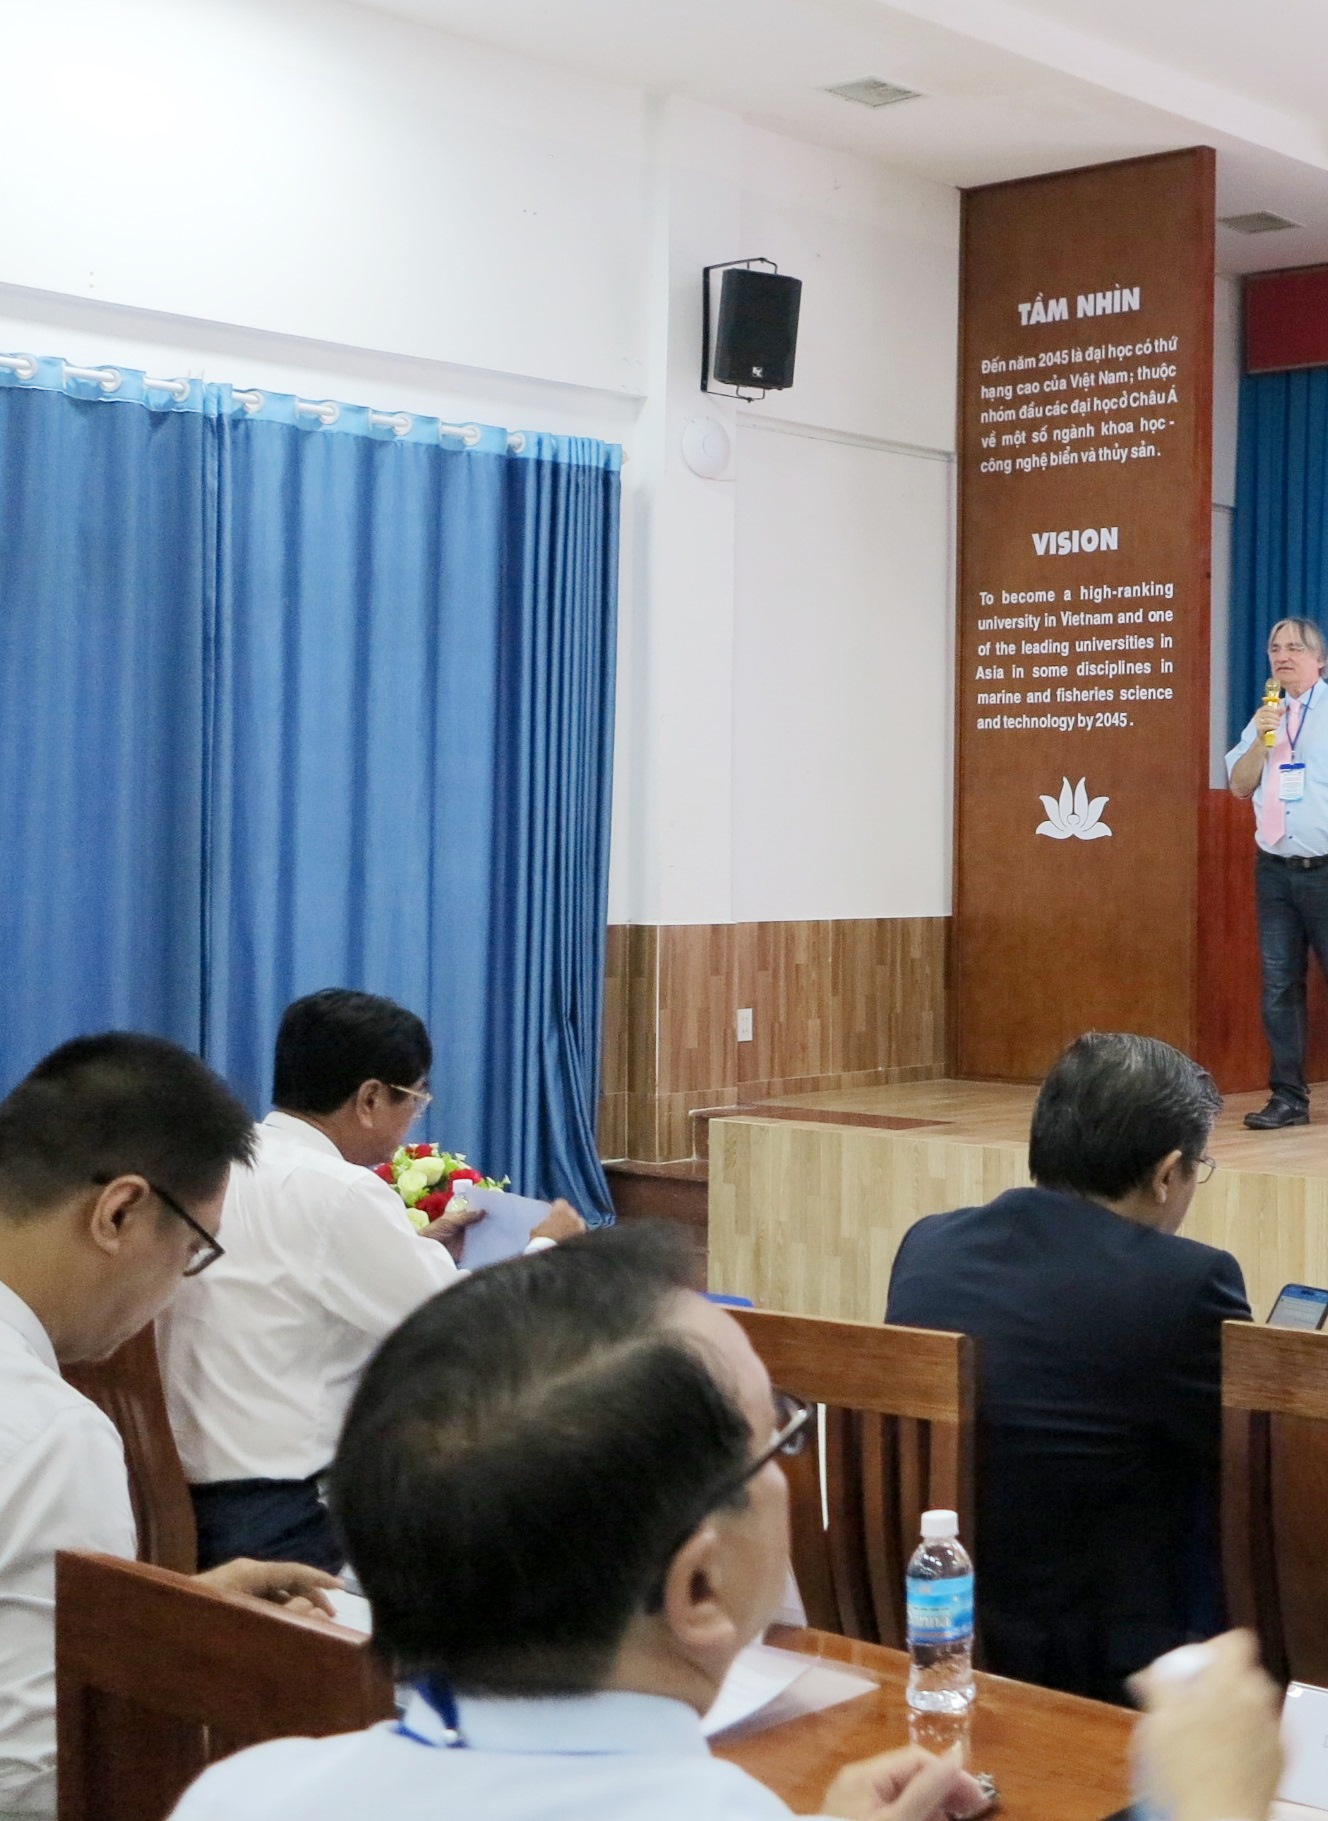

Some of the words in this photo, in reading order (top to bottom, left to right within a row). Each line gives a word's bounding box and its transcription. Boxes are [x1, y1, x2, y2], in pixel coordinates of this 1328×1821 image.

[1018, 291, 1069, 327] TẦM
[1076, 283, 1141, 319] NHÌN
[981, 356, 1007, 374] Đến
[1009, 356, 1036, 371] năm
[1038, 350, 1069, 368] 2045
[1071, 348, 1083, 364] là
[1085, 344, 1106, 363] đại
[1108, 343, 1133, 360] học
[1135, 338, 1152, 355] có
[1154, 335, 1179, 354] thứ
[981, 384, 1013, 401] hạng
[1016, 381, 1041, 396] cao
[1043, 374, 1068, 392] của
[1070, 372, 1095, 392] Việt
[1137, 362, 1177, 382] thuộc
[980, 404, 1016, 424] nhóm
[1019, 401, 1044, 420] đầu
[1045, 399, 1068, 416] các
[1070, 398, 1091, 417] đại
[1129, 390, 1164, 408] Châu
[1167, 384, 1178, 403] Á
[981, 429, 997, 449] về
[1001, 427, 1026, 448] một
[1031, 424, 1049, 444] số
[1053, 422, 1095, 444] ngành
[1101, 420, 1134, 437] khoa
[1140, 416, 1166, 435] học
[980, 457, 1012, 475] công
[1016, 450, 1049, 471] nghệ
[1050, 445, 1078, 467] biển
[1081, 446, 1096, 462] và
[1098, 442, 1128, 464] thủy
[1032, 526, 1119, 556] VISION
[979, 591, 994, 606] To
[1001, 589, 1055, 605] become
[1063, 588, 1072, 601] a
[1080, 581, 1174, 603] high-ranking
[977, 613, 1041, 632] university
[1044, 612, 1056, 627] in
[1060, 610, 1113, 627] Vietnam
[1117, 608, 1143, 624] and
[1148, 609, 1173, 623] one
[978, 641, 991, 657] of
[995, 640, 1016, 656] the
[1021, 638, 1070, 657] leading
[1075, 634, 1154, 653] universities
[1160, 633, 1173, 648] in
[975, 665, 1004, 681] Asia
[1012, 664, 1024, 679] in
[1032, 663, 1068, 678] some
[1076, 659, 1151, 679] disciplines
[1161, 658, 1173, 674] in
[977, 689, 1021, 705] marine
[1026, 688, 1051, 704] and
[1056, 686, 1114, 702] fisheries
[1119, 685, 1173, 701] science
[976, 714, 1001, 730] and
[1003, 712, 1075, 732] technology
[1077, 712, 1094, 731] by
